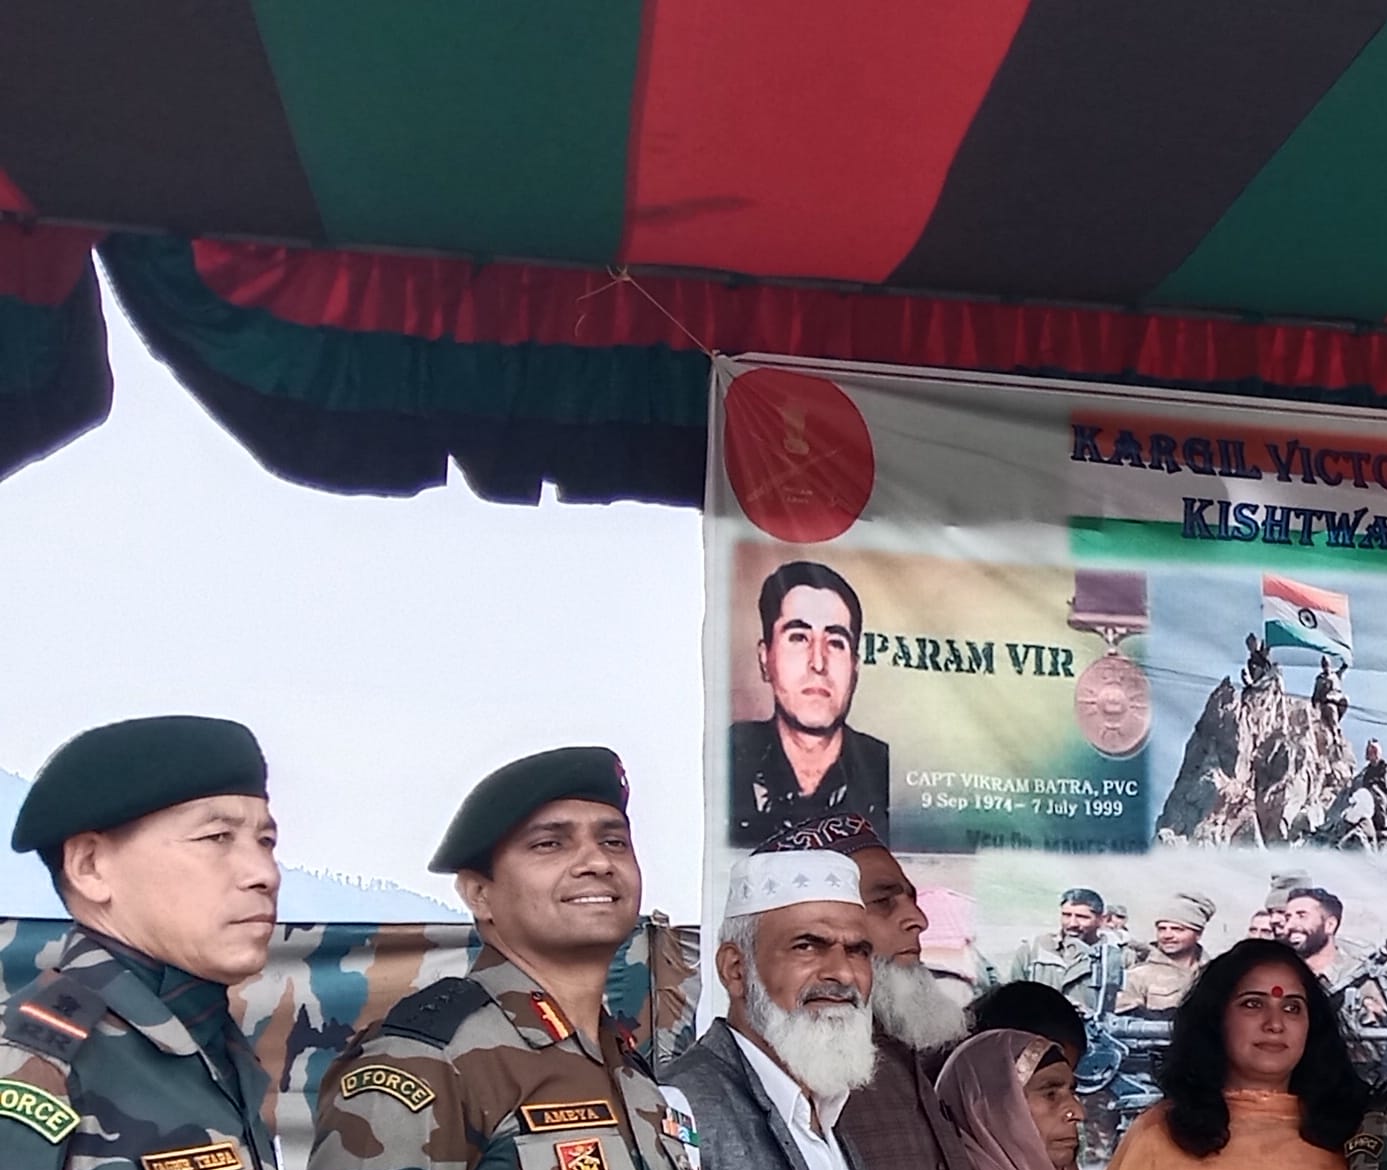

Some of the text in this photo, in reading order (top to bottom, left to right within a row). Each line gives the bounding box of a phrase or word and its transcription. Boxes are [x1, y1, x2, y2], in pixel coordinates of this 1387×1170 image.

[1071, 423, 1261, 480] KARGIL
[863, 632, 1075, 678] PARAM VIR
[906, 771, 1138, 798] CAPT VIKRAM BATRA, PVC
[921, 792, 932, 807] 9
[936, 793, 967, 811] Sep
[1032, 799, 1040, 814] 7
[1046, 800, 1078, 817] July
[1084, 801, 1123, 816] 1999
[346, 1070, 427, 1103] D FORCE
[0, 1089, 70, 1131] ORCE
